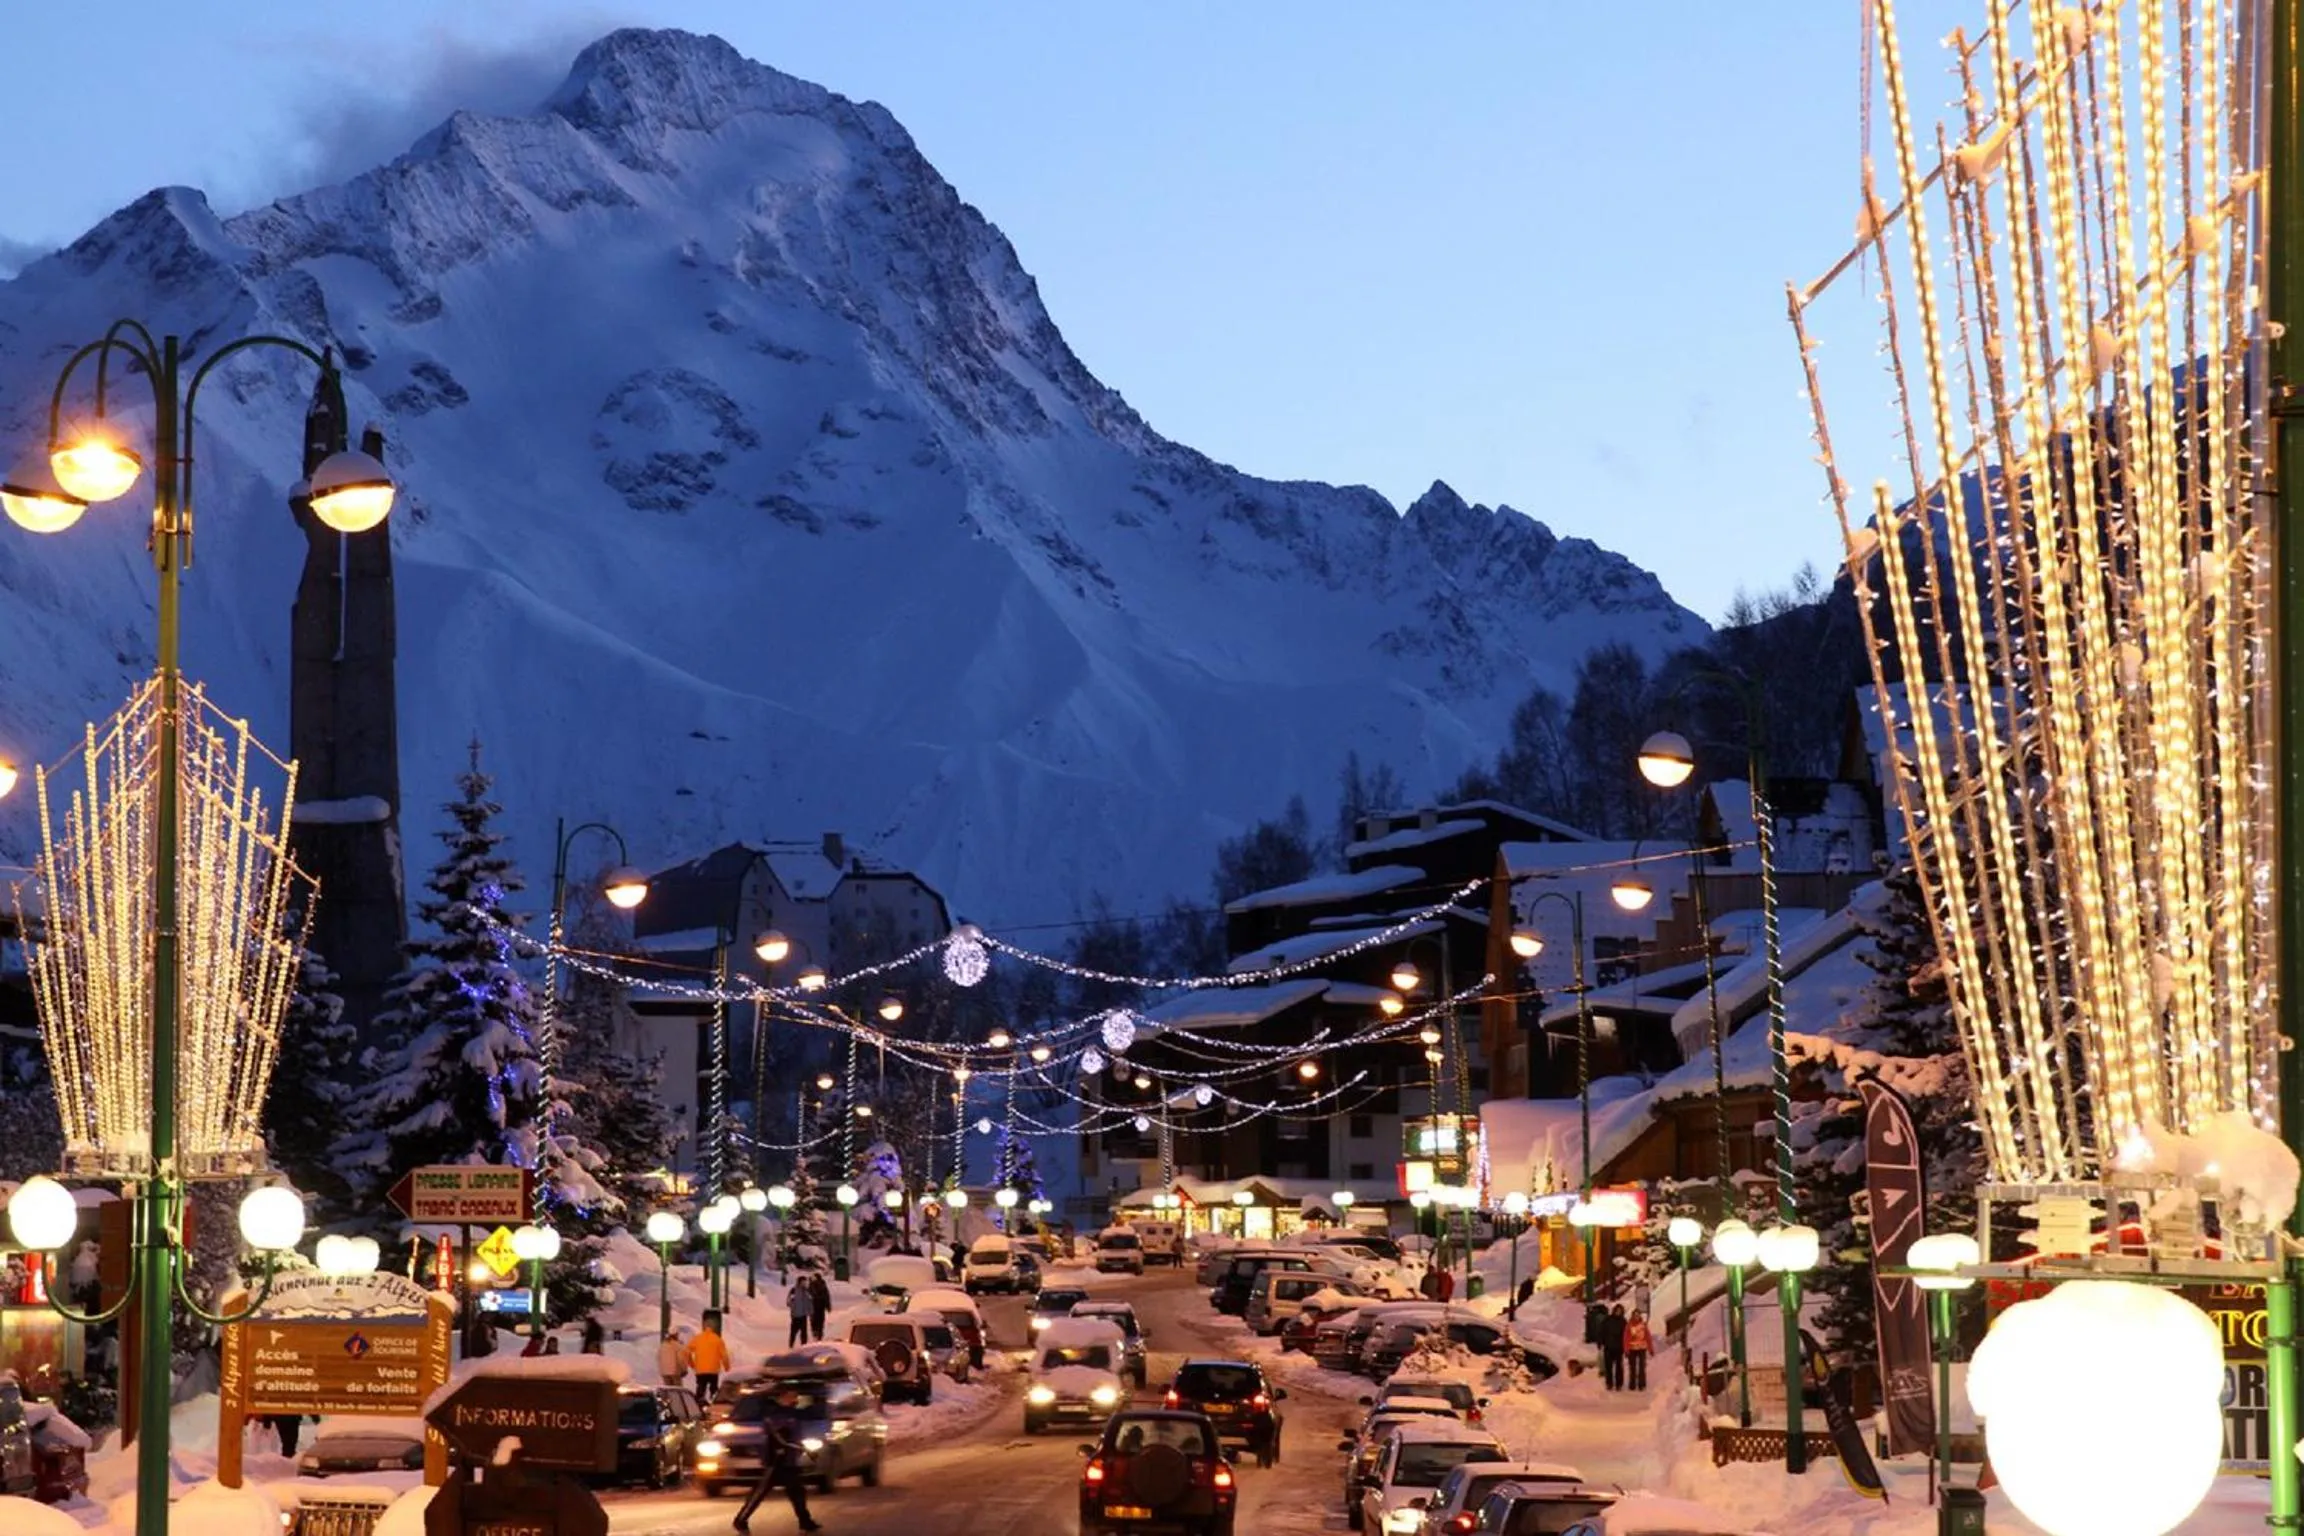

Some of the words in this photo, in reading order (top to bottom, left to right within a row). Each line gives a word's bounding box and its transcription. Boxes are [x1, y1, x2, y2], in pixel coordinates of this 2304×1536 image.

[416, 1173, 461, 1189] PRESSE
[416, 1201, 456, 1216] TABAC
[461, 1201, 517, 1216] CADEAUX
[336, 1274, 362, 1287] aux
[366, 1274, 379, 1289] 2
[378, 1277, 424, 1303] Alpes
[255, 1348, 299, 1361] Accès
[223, 1354, 241, 1396] Alpes
[255, 1365, 315, 1377] domaine
[377, 1367, 418, 1379] Vente
[254, 1380, 320, 1393] d'altitude
[346, 1382, 363, 1394] de
[366, 1382, 418, 1395] forfaits
[455, 1404, 594, 1430] INFORMATIONS
